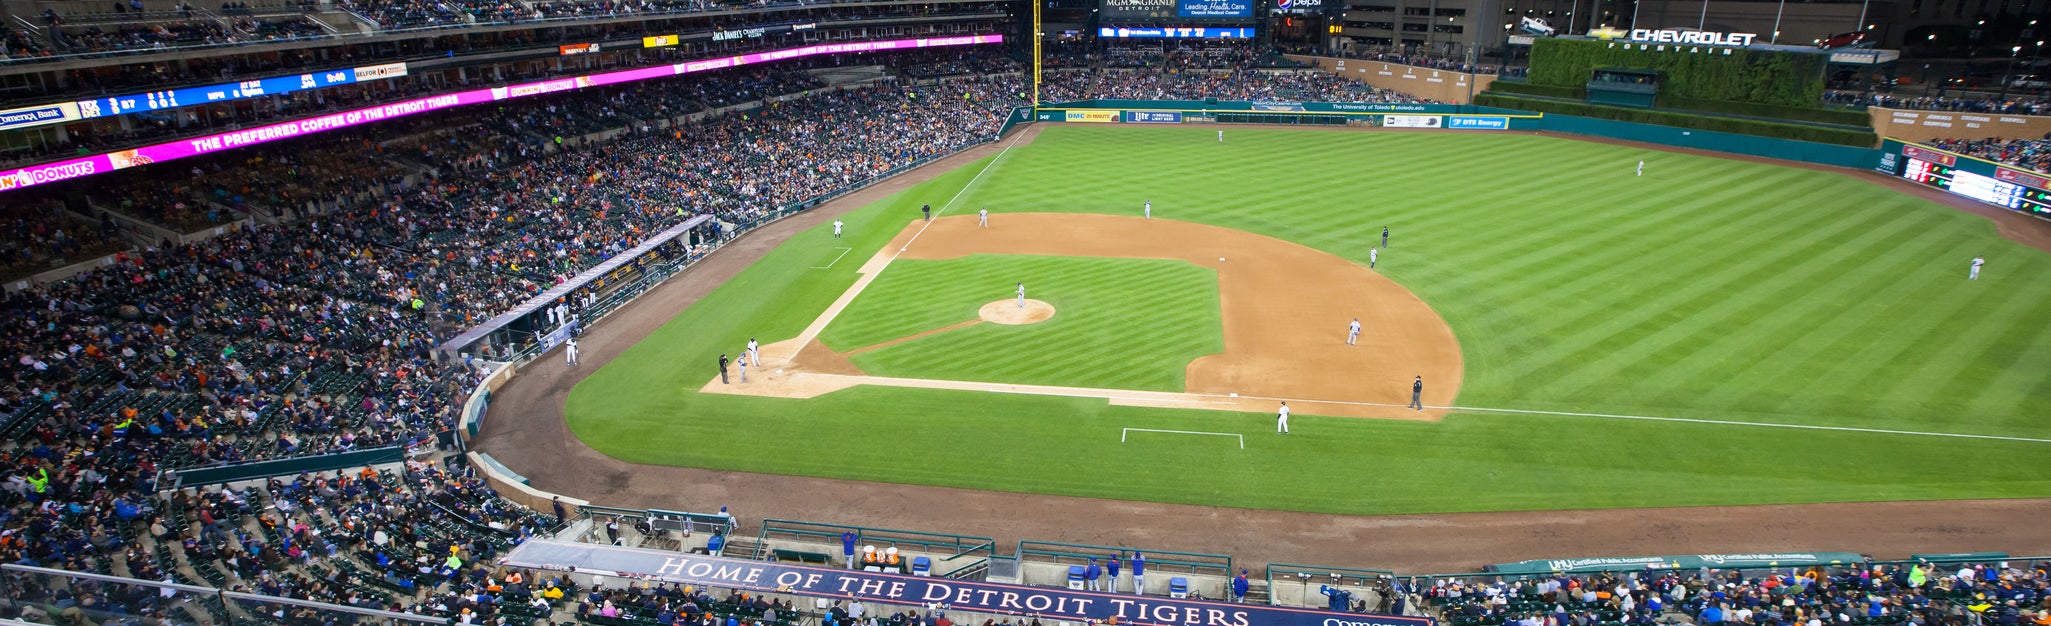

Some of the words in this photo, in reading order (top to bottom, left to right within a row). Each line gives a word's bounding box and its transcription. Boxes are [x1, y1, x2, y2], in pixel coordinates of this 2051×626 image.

[712, 31, 724, 41] JACK
[724, 29, 743, 40] DANIEL'S
[1631, 28, 1757, 46] CHEVROLET
[1608, 42, 1732, 55] FOUNTAIN
[355, 69, 377, 78] BELFOR
[546, 81, 573, 92] DONUTS
[1343, 103, 1367, 111] University
[37, 108, 60, 119] Bank
[1135, 112, 1150, 121] Lite
[191, 137, 222, 152] THE
[223, 125, 300, 148] PREFERRED
[300, 117, 345, 133] COFFEE
[346, 113, 363, 124] OF
[363, 107, 385, 120] THE
[385, 98, 427, 117] DETROIT
[427, 95, 459, 109] TIGERS
[1477, 119, 1502, 127] Energy
[33, 160, 95, 185] DONUTS
[1572, 558, 1601, 567] Certified
[1601, 557, 1622, 566] Public
[1622, 556, 1664, 564] Accountants
[658, 557, 764, 584] HOME
[777, 571, 823, 589] OF
[837, 576, 907, 598] THE
[922, 583, 1091, 614] DETROIT
[1109, 598, 1250, 626] TIGERS
